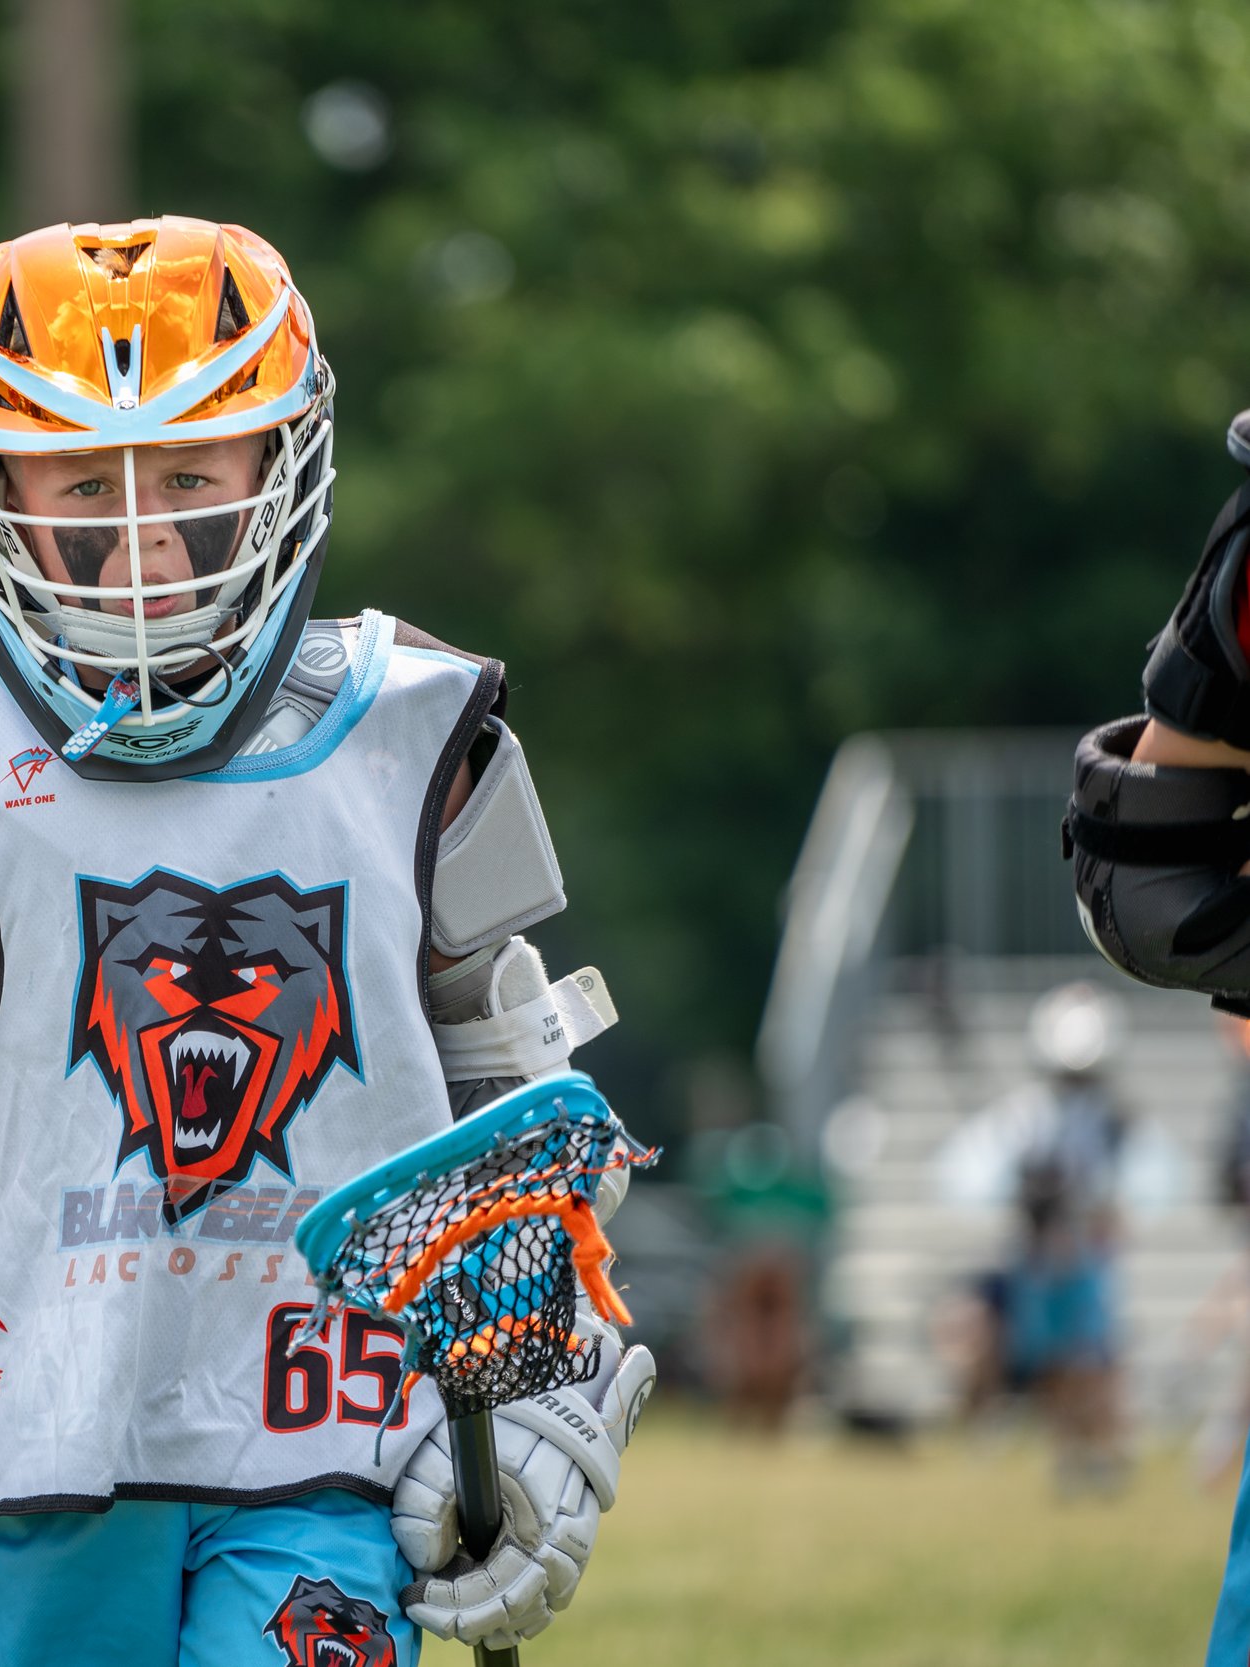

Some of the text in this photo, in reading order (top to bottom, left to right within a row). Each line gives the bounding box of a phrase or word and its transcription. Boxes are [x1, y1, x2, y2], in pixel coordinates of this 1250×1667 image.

[110, 744, 190, 760] cascade
[5, 794, 55, 809] WAVE ONE
[184, 1179, 322, 1249] BEA
[65, 1247, 316, 1287] LACOSS
[263, 1302, 410, 1434] 65
[528, 1393, 599, 1444] RIOR
